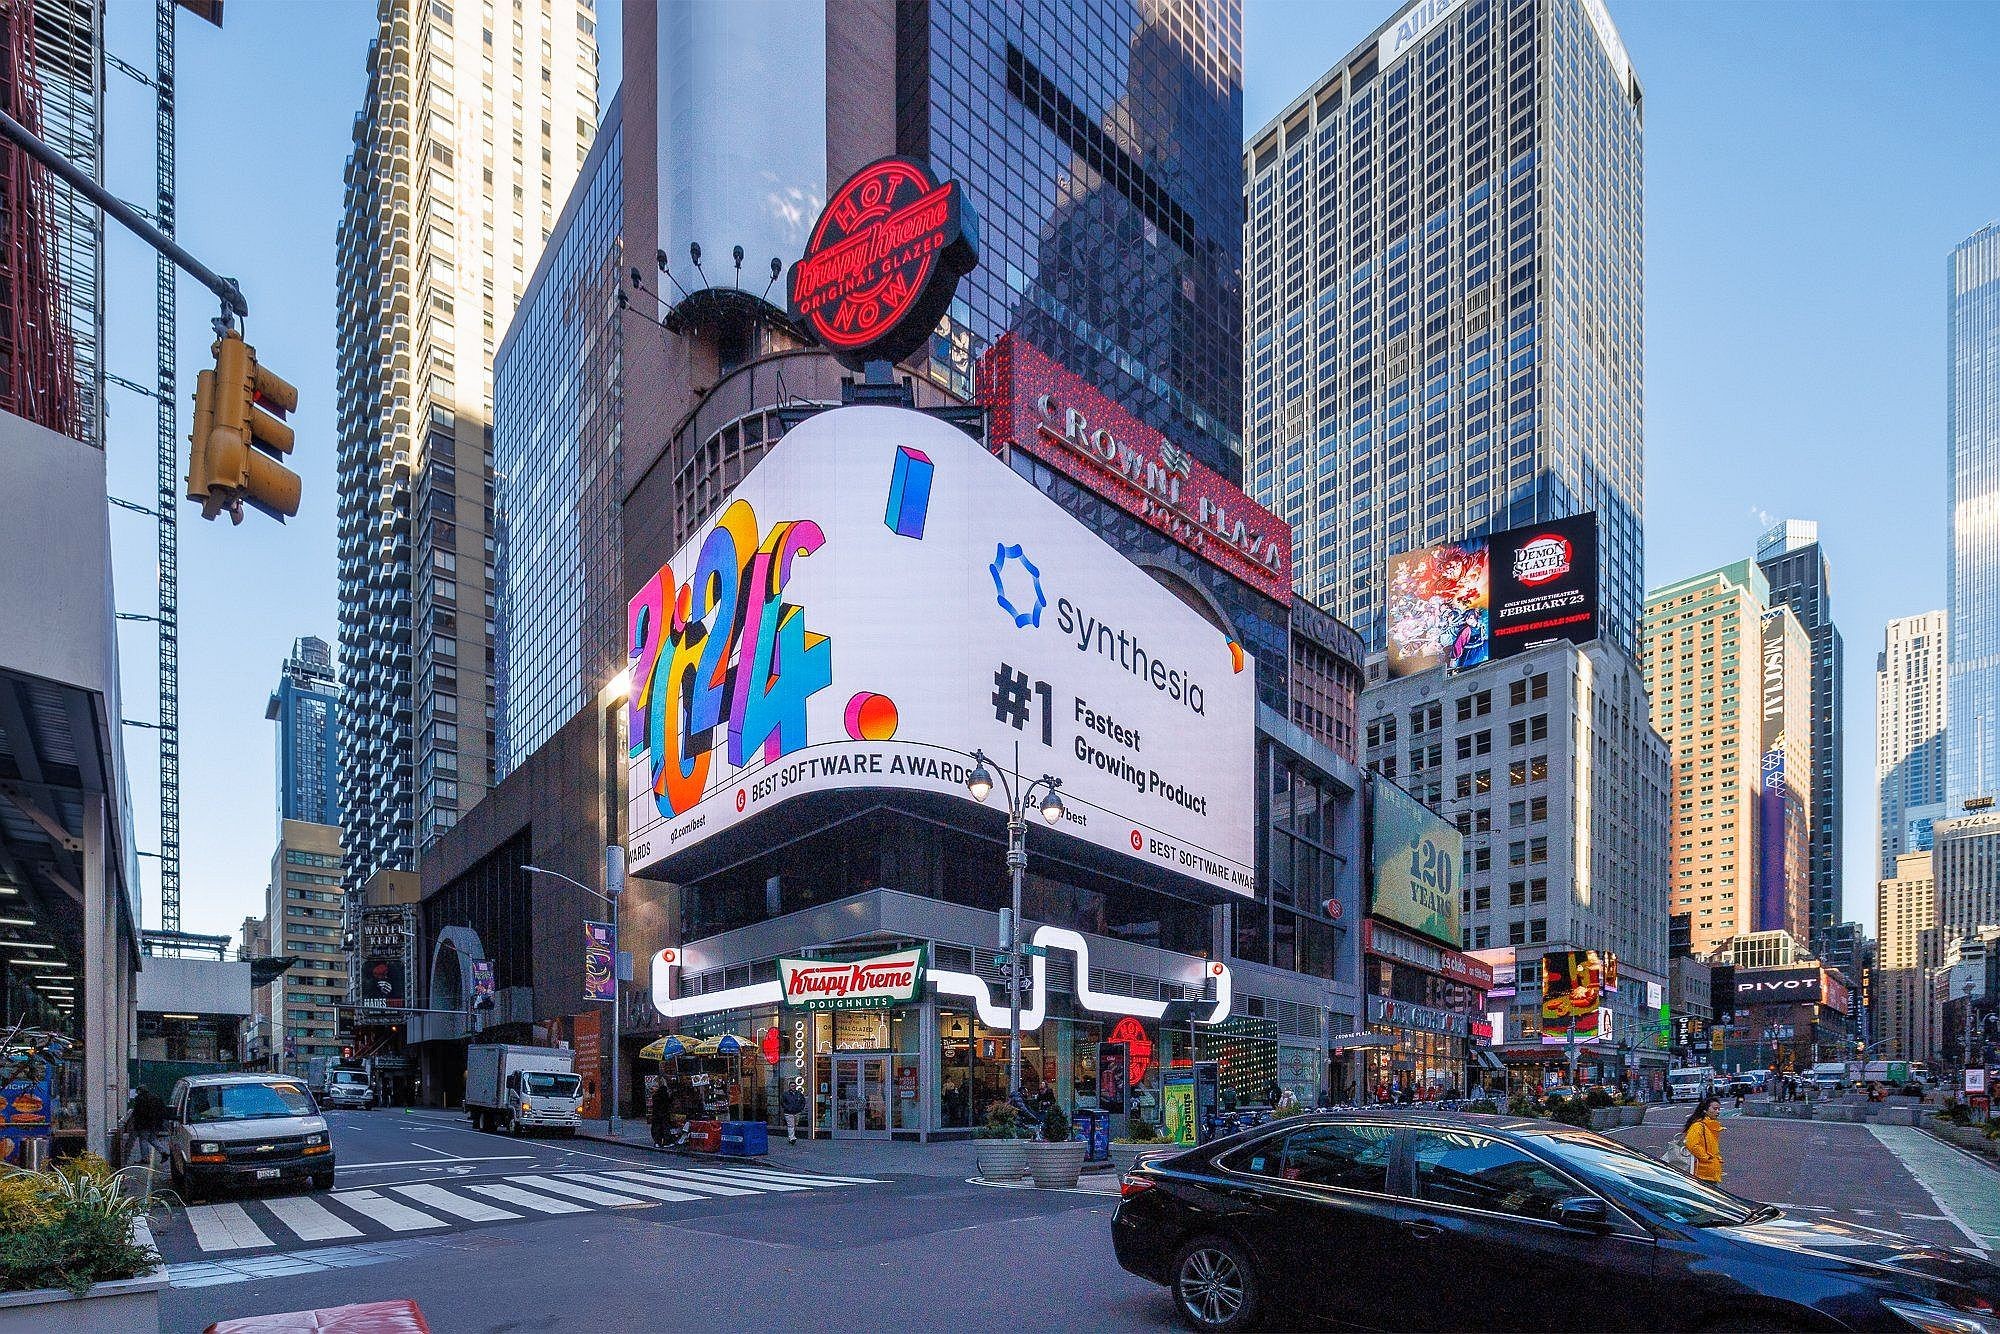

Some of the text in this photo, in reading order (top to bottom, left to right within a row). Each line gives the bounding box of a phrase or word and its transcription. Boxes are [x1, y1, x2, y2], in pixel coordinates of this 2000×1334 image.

[834, 174, 904, 234] HOT
[795, 181, 953, 301] Krispy Kreme
[801, 231, 945, 314] ORIGINAL GLAZED
[833, 271, 908, 331] NOW
[1512, 554, 1567, 578] SLAYER
[1514, 540, 1567, 563] DEMON
[1499, 594, 1585, 618] FEBRUARY 23
[1528, 596, 1548, 604] MOVIE
[1547, 589, 1579, 599] THEATERS
[1494, 612, 1591, 637] TICKETS ON SALE NOW!
[1057, 597, 1206, 717] synthesia
[991, 661, 1053, 748] #1
[1074, 696, 1141, 753] Fastest
[752, 773, 779, 803] BEST
[781, 753, 883, 788] SOFTWARE
[1074, 735, 1207, 817] Growing Product
[670, 815, 706, 845] g2.com/best
[1025, 794, 1088, 827] g2./best
[1149, 838, 1177, 861] BEST
[1179, 850, 1230, 881] SOFTWARE
[1410, 838, 1452, 895] 120
[1410, 880, 1452, 917] YEARS
[788, 961, 915, 996] Krispy Kreme
[1738, 978, 1818, 993] PIVOT
[809, 997, 888, 1010] DOUGHNUTS
[1335, 1032, 1355, 1040] CROWNE
[1183, 1093, 1195, 1142] shucked
